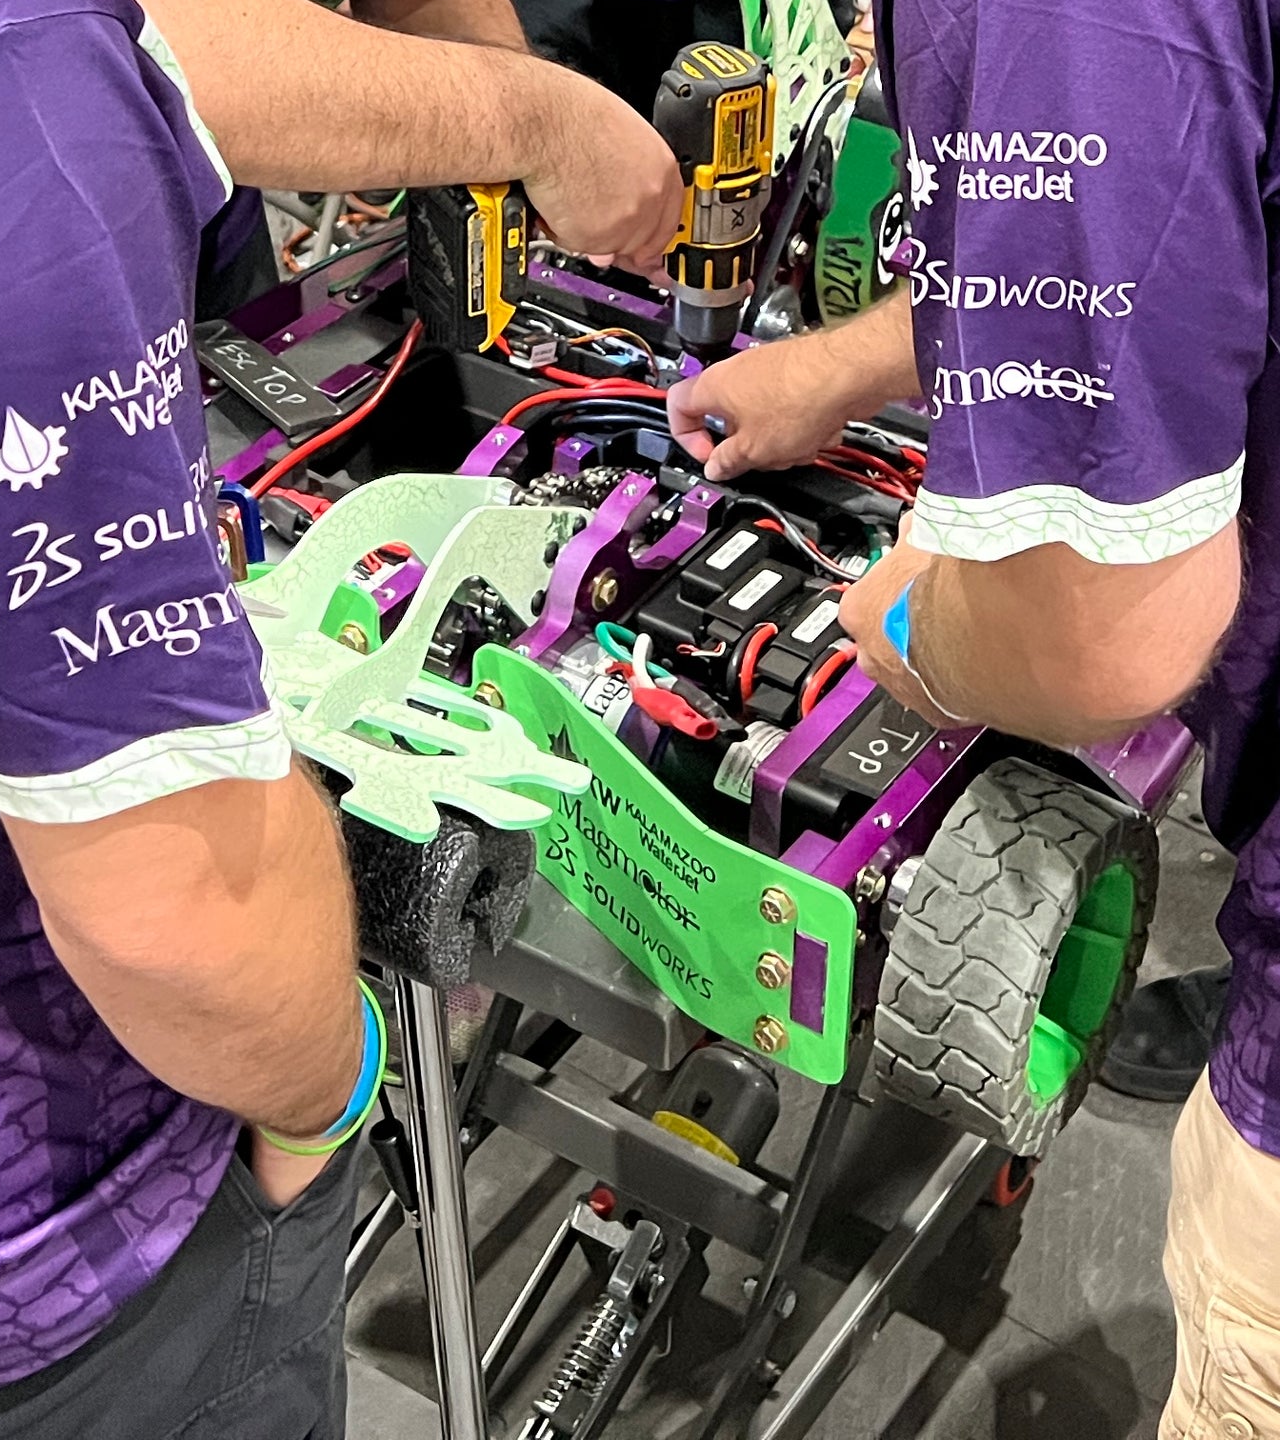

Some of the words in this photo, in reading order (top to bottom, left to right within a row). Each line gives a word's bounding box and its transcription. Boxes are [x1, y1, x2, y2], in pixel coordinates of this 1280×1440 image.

[957, 165, 1075, 203] aterJet
[558, 791, 702, 932] Magmotor
[625, 798, 717, 885] KALAMAZOO
[638, 825, 700, 894] WaterJet
[582, 871, 715, 1001] SOLIDWORKS
